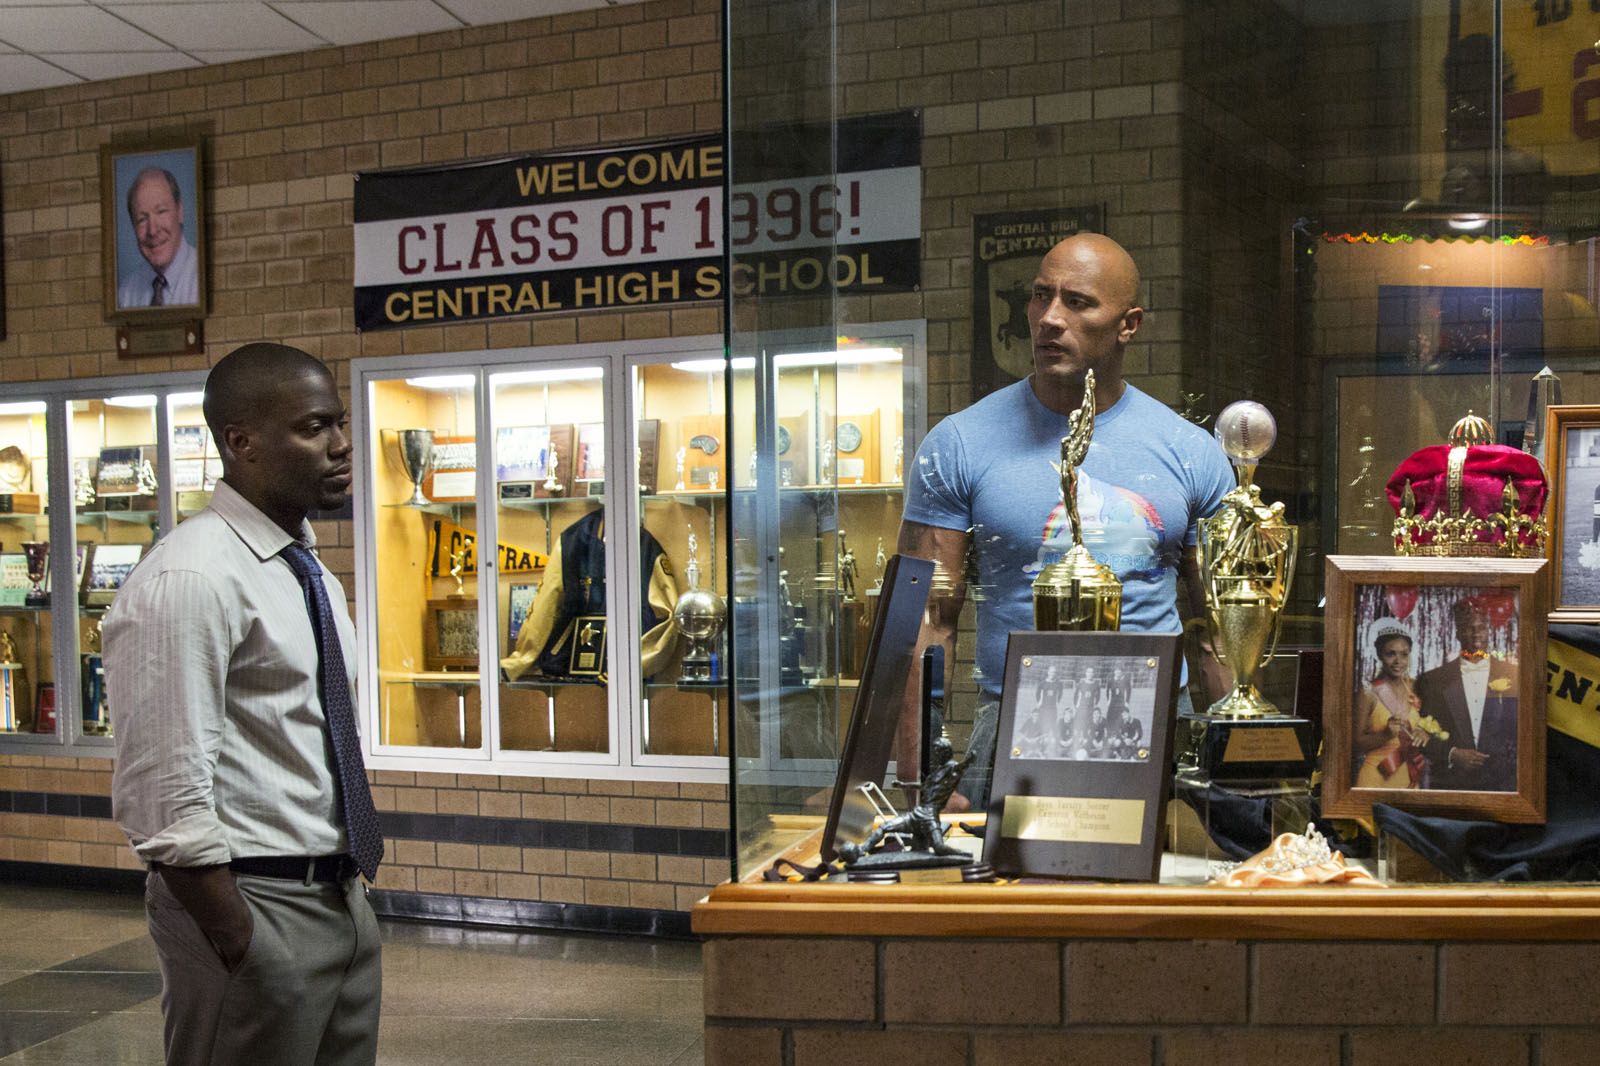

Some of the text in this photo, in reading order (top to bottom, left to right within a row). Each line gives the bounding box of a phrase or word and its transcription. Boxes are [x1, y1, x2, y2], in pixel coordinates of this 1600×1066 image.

[515, 146, 723, 197] WELCOME
[398, 180, 861, 276] CLASS OF 1996!
[994, 220, 1078, 236] CENTRAL HIGH
[384, 252, 885, 322] CENTRAL HIGH SCHOOL
